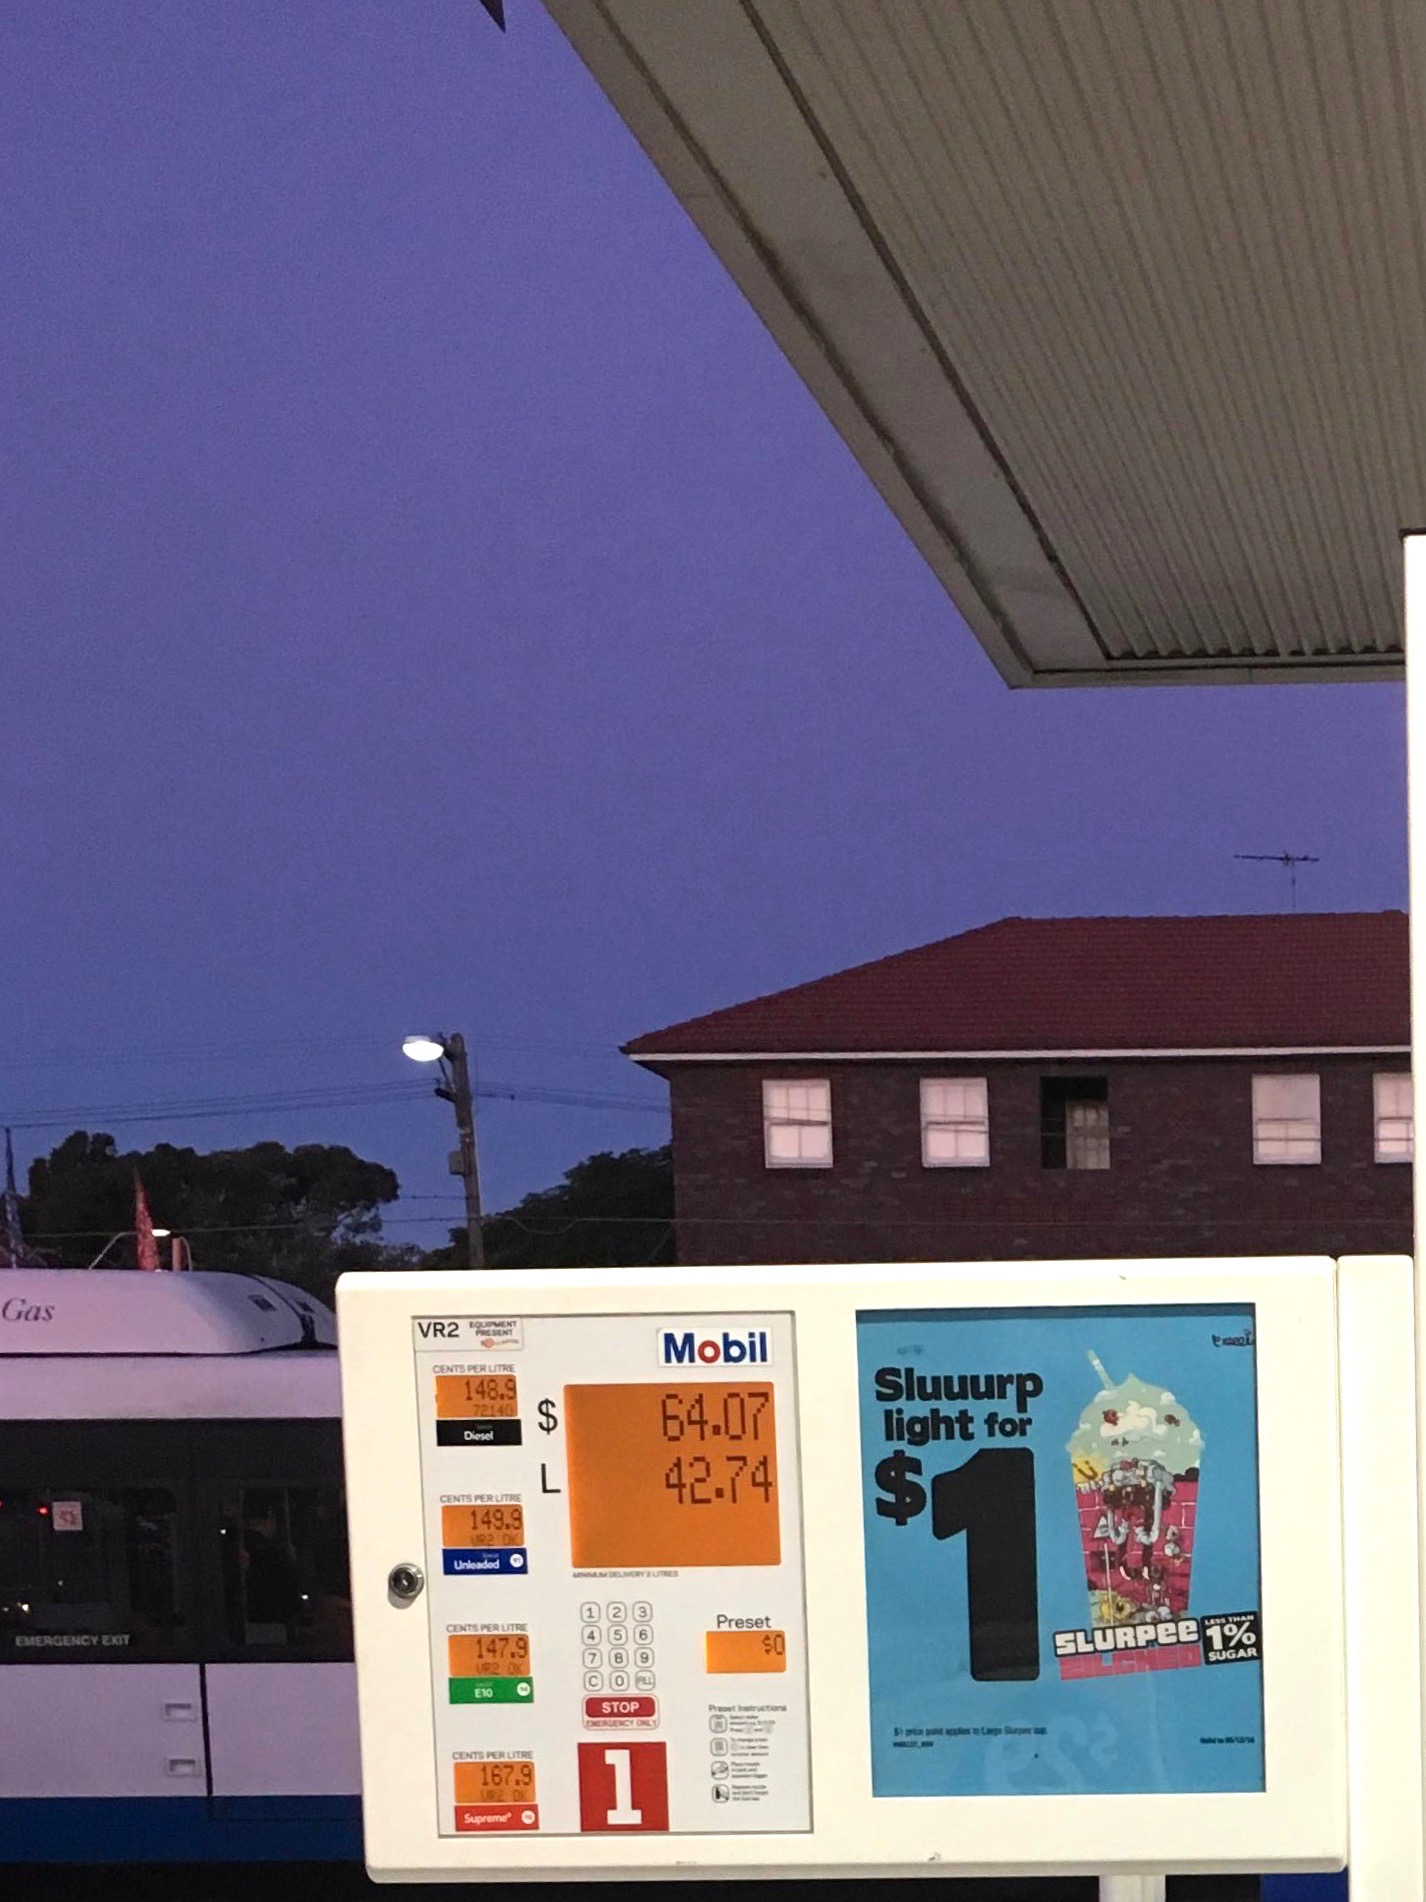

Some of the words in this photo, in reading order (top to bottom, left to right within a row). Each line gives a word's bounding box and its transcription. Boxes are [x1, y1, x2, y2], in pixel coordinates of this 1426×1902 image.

[2, 1297, 55, 1322] Gas
[417, 1321, 460, 1338] VR2
[469, 1321, 518, 1329] EQUIPMENT
[663, 1332, 768, 1364] Mobil
[432, 1365, 465, 1374] CENTS
[468, 1364, 487, 1373] PER
[489, 1363, 515, 1373] LITRE
[465, 1379, 517, 1401] 148.9
[875, 1366, 1044, 1414] Sluuurp
[538, 1398, 558, 1435] $
[661, 1392, 769, 1442] 64.07
[884, 1408, 975, 1446] light
[984, 1412, 1032, 1437] for
[464, 1431, 494, 1441] Diesel
[541, 1463, 561, 1494] L
[665, 1455, 773, 1505] 42.74
[440, 1494, 473, 1503] CENTS
[474, 1494, 493, 1503] PER
[496, 1494, 522, 1502] LITRE
[471, 1508, 522, 1530] 149.9
[454, 1560, 499, 1570] Unleaded
[586, 1607, 595, 1618] 1
[612, 1606, 622, 1618] 2
[638, 1606, 647, 1618] 3
[716, 1614, 772, 1629] Preset
[1205, 1617, 1226, 1626] LESS
[1228, 1615, 1254, 1623] THAN
[446, 1624, 478, 1633] CENTS
[481, 1624, 499, 1632] PER
[502, 1623, 528, 1632] LITRE
[639, 1628, 648, 1640] 6
[15, 1635, 98, 1646] EMERGENCY
[102, 1634, 130, 1645] EXIT
[586, 1630, 596, 1641] 4
[613, 1629, 623, 1641] 5
[1206, 1621, 1257, 1651] 1%
[477, 1637, 528, 1658] 147.9
[762, 1634, 784, 1656] $0
[588, 1652, 597, 1664] 7
[614, 1652, 623, 1664] 8
[640, 1652, 649, 1663] 9
[1208, 1647, 1258, 1661] SUGAR
[588, 1675, 599, 1687] C
[615, 1675, 624, 1687] 0
[474, 1688, 493, 1698] E10
[602, 1701, 640, 1714] STOP
[708, 1704, 736, 1712] Preset
[737, 1704, 787, 1712] Instructions
[586, 1719, 634, 1728] EMERGENCY
[636, 1719, 657, 1727] ONLY
[452, 1751, 484, 1760] CENTS
[486, 1751, 505, 1759] PER
[507, 1750, 533, 1759] LITRE
[482, 1764, 532, 1786] 167.9
[604, 1749, 642, 1825] 1
